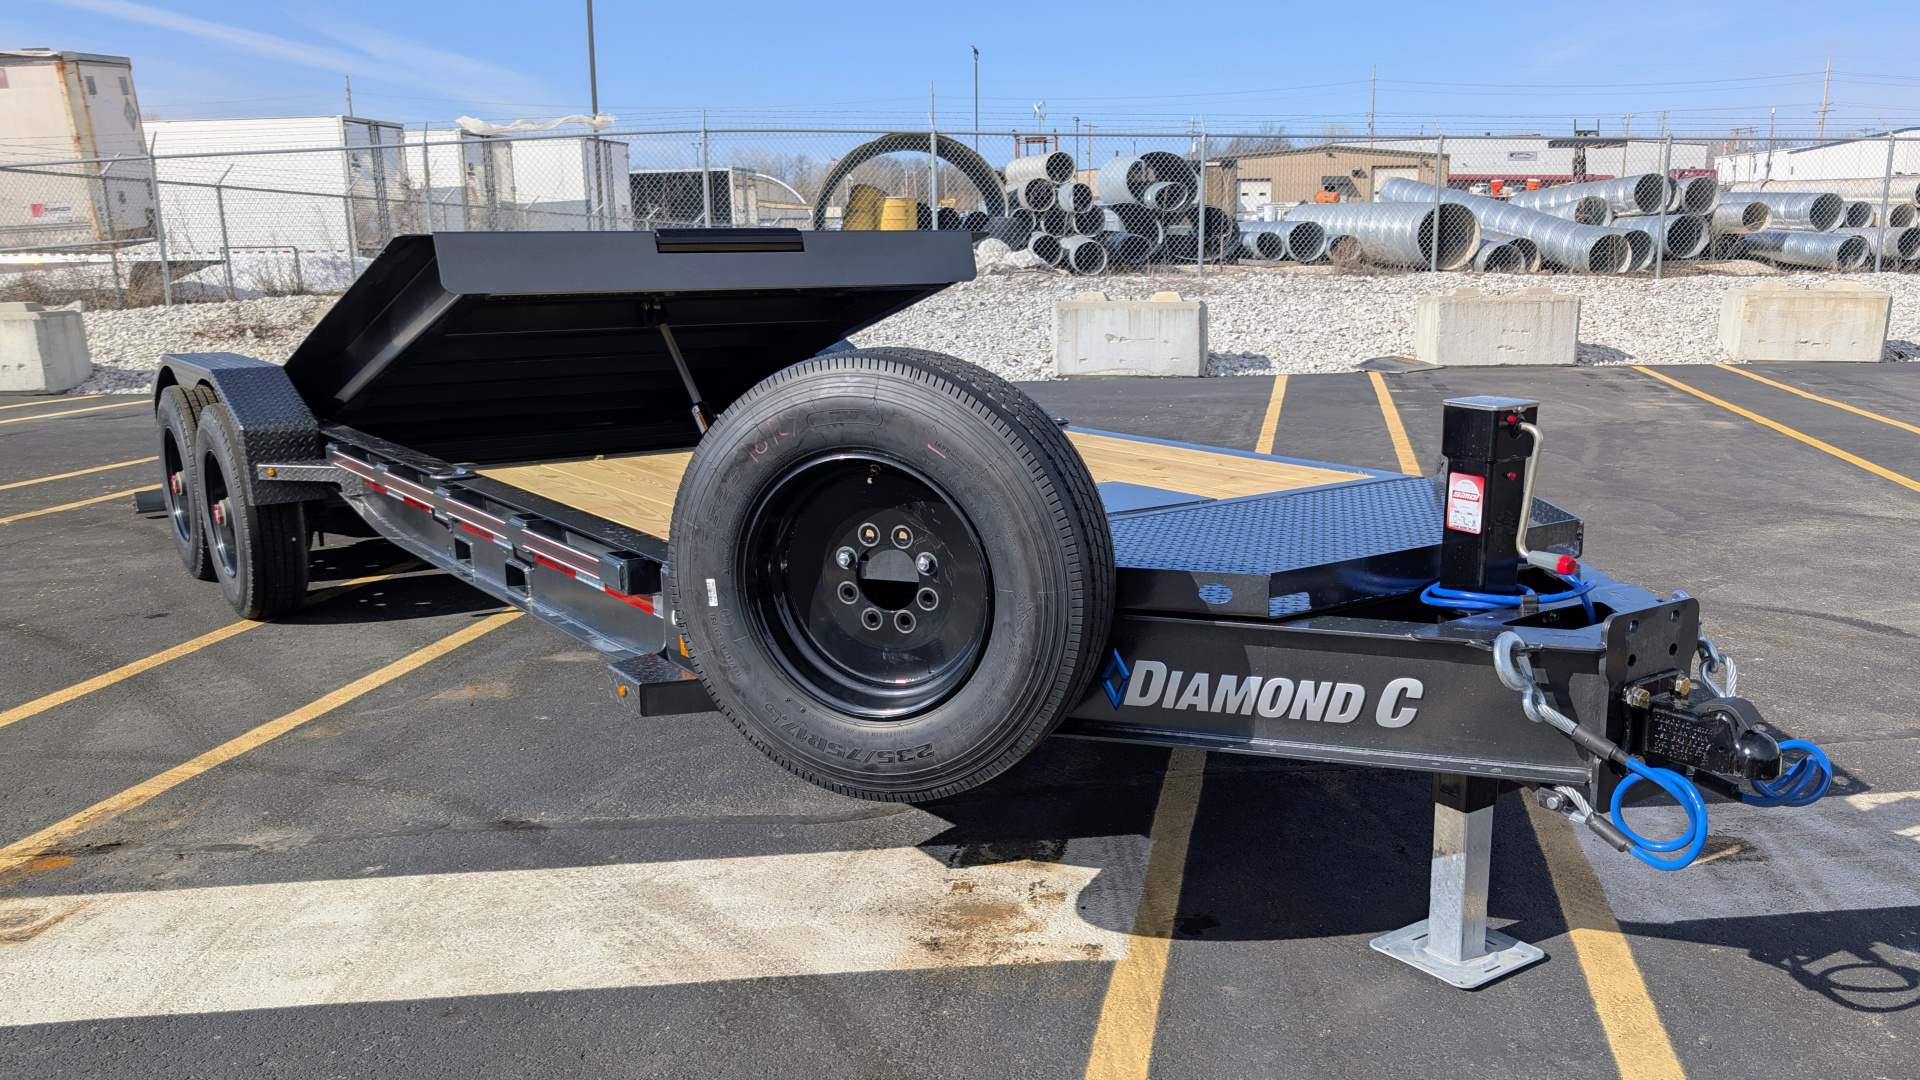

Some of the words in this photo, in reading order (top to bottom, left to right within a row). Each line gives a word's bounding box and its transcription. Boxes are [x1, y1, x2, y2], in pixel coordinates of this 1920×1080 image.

[1124, 660, 1365, 723] DIAMOND
[1375, 677, 1423, 727] C
[761, 702, 935, 764] 235/75R17.5
